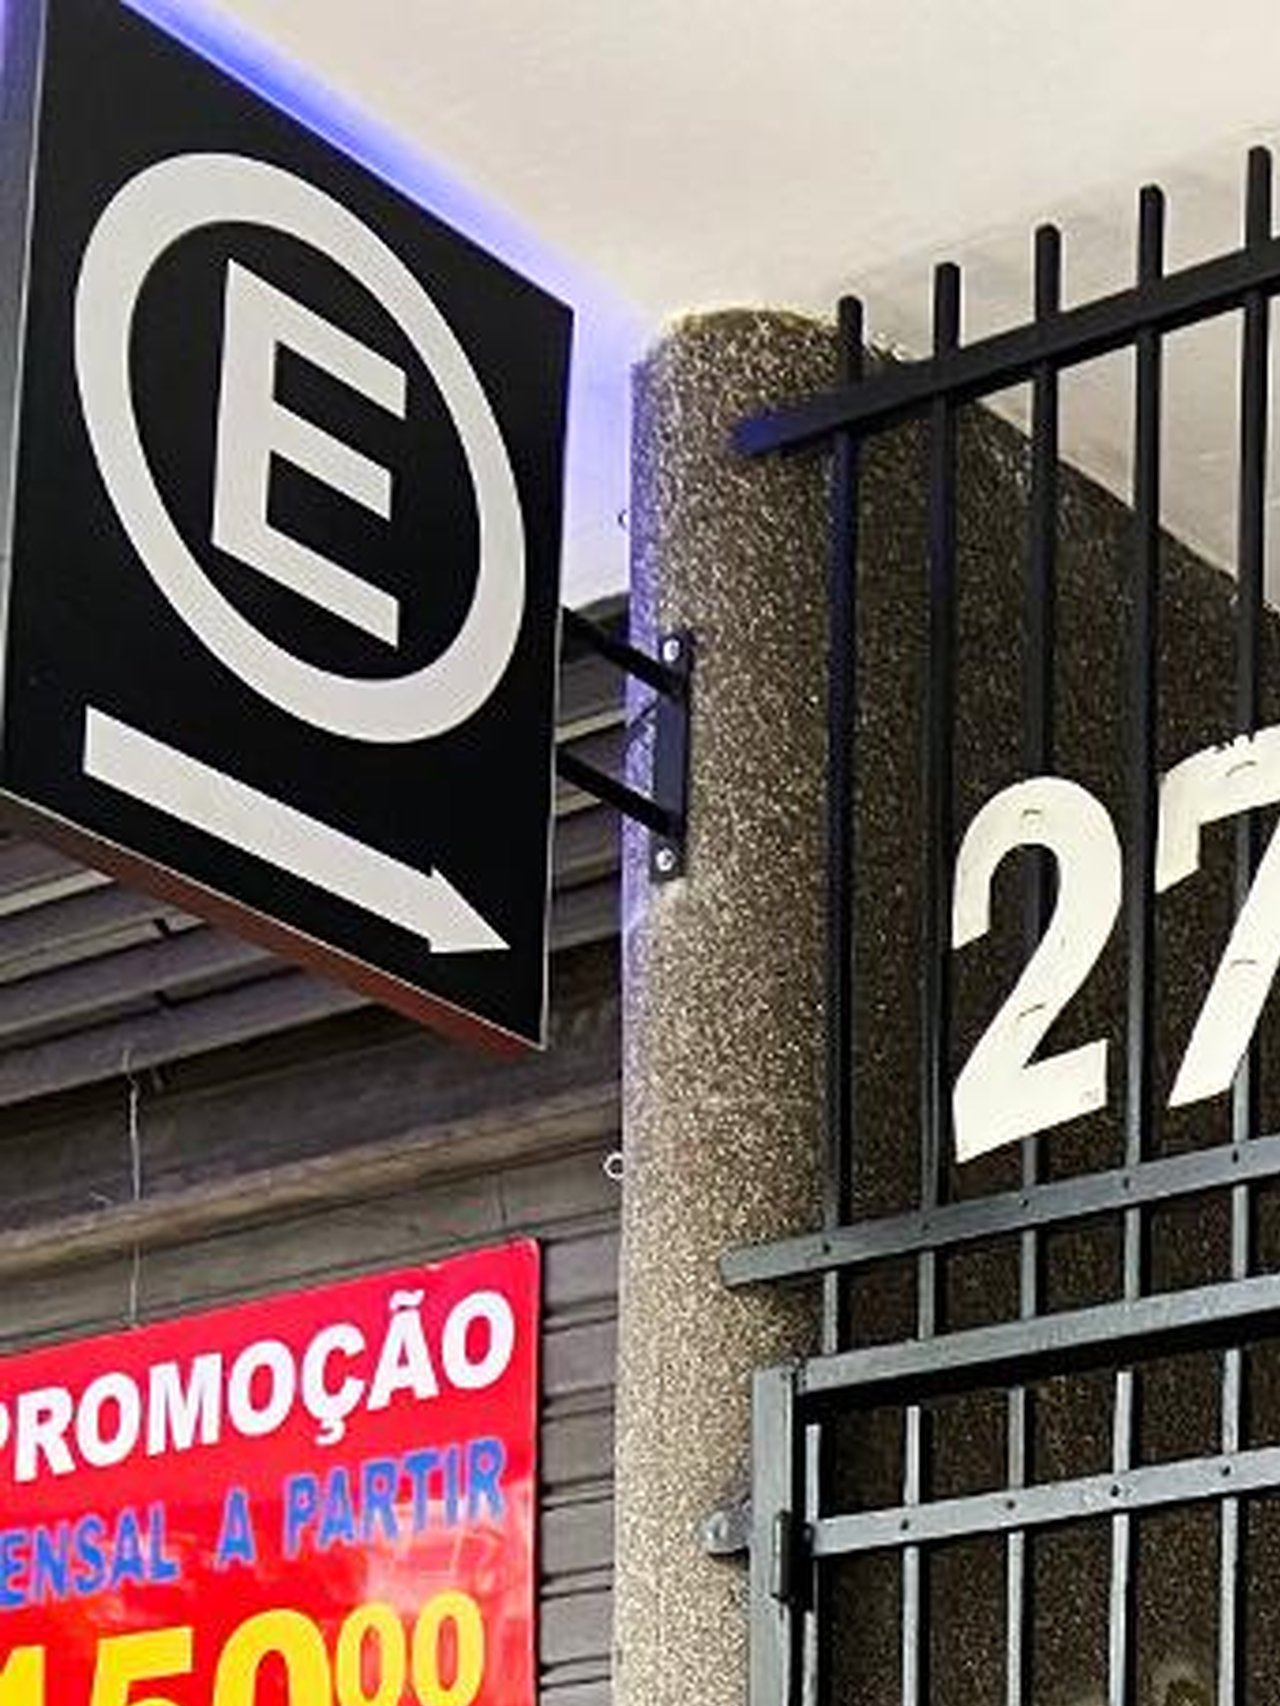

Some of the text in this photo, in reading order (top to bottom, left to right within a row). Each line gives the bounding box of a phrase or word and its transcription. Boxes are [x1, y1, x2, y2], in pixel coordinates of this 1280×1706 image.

[211, 258, 408, 648] E
[0, 1289, 515, 1482] ROMOÇÃO
[217, 1486, 257, 1566] A
[285, 1438, 507, 1559] PARTIR
